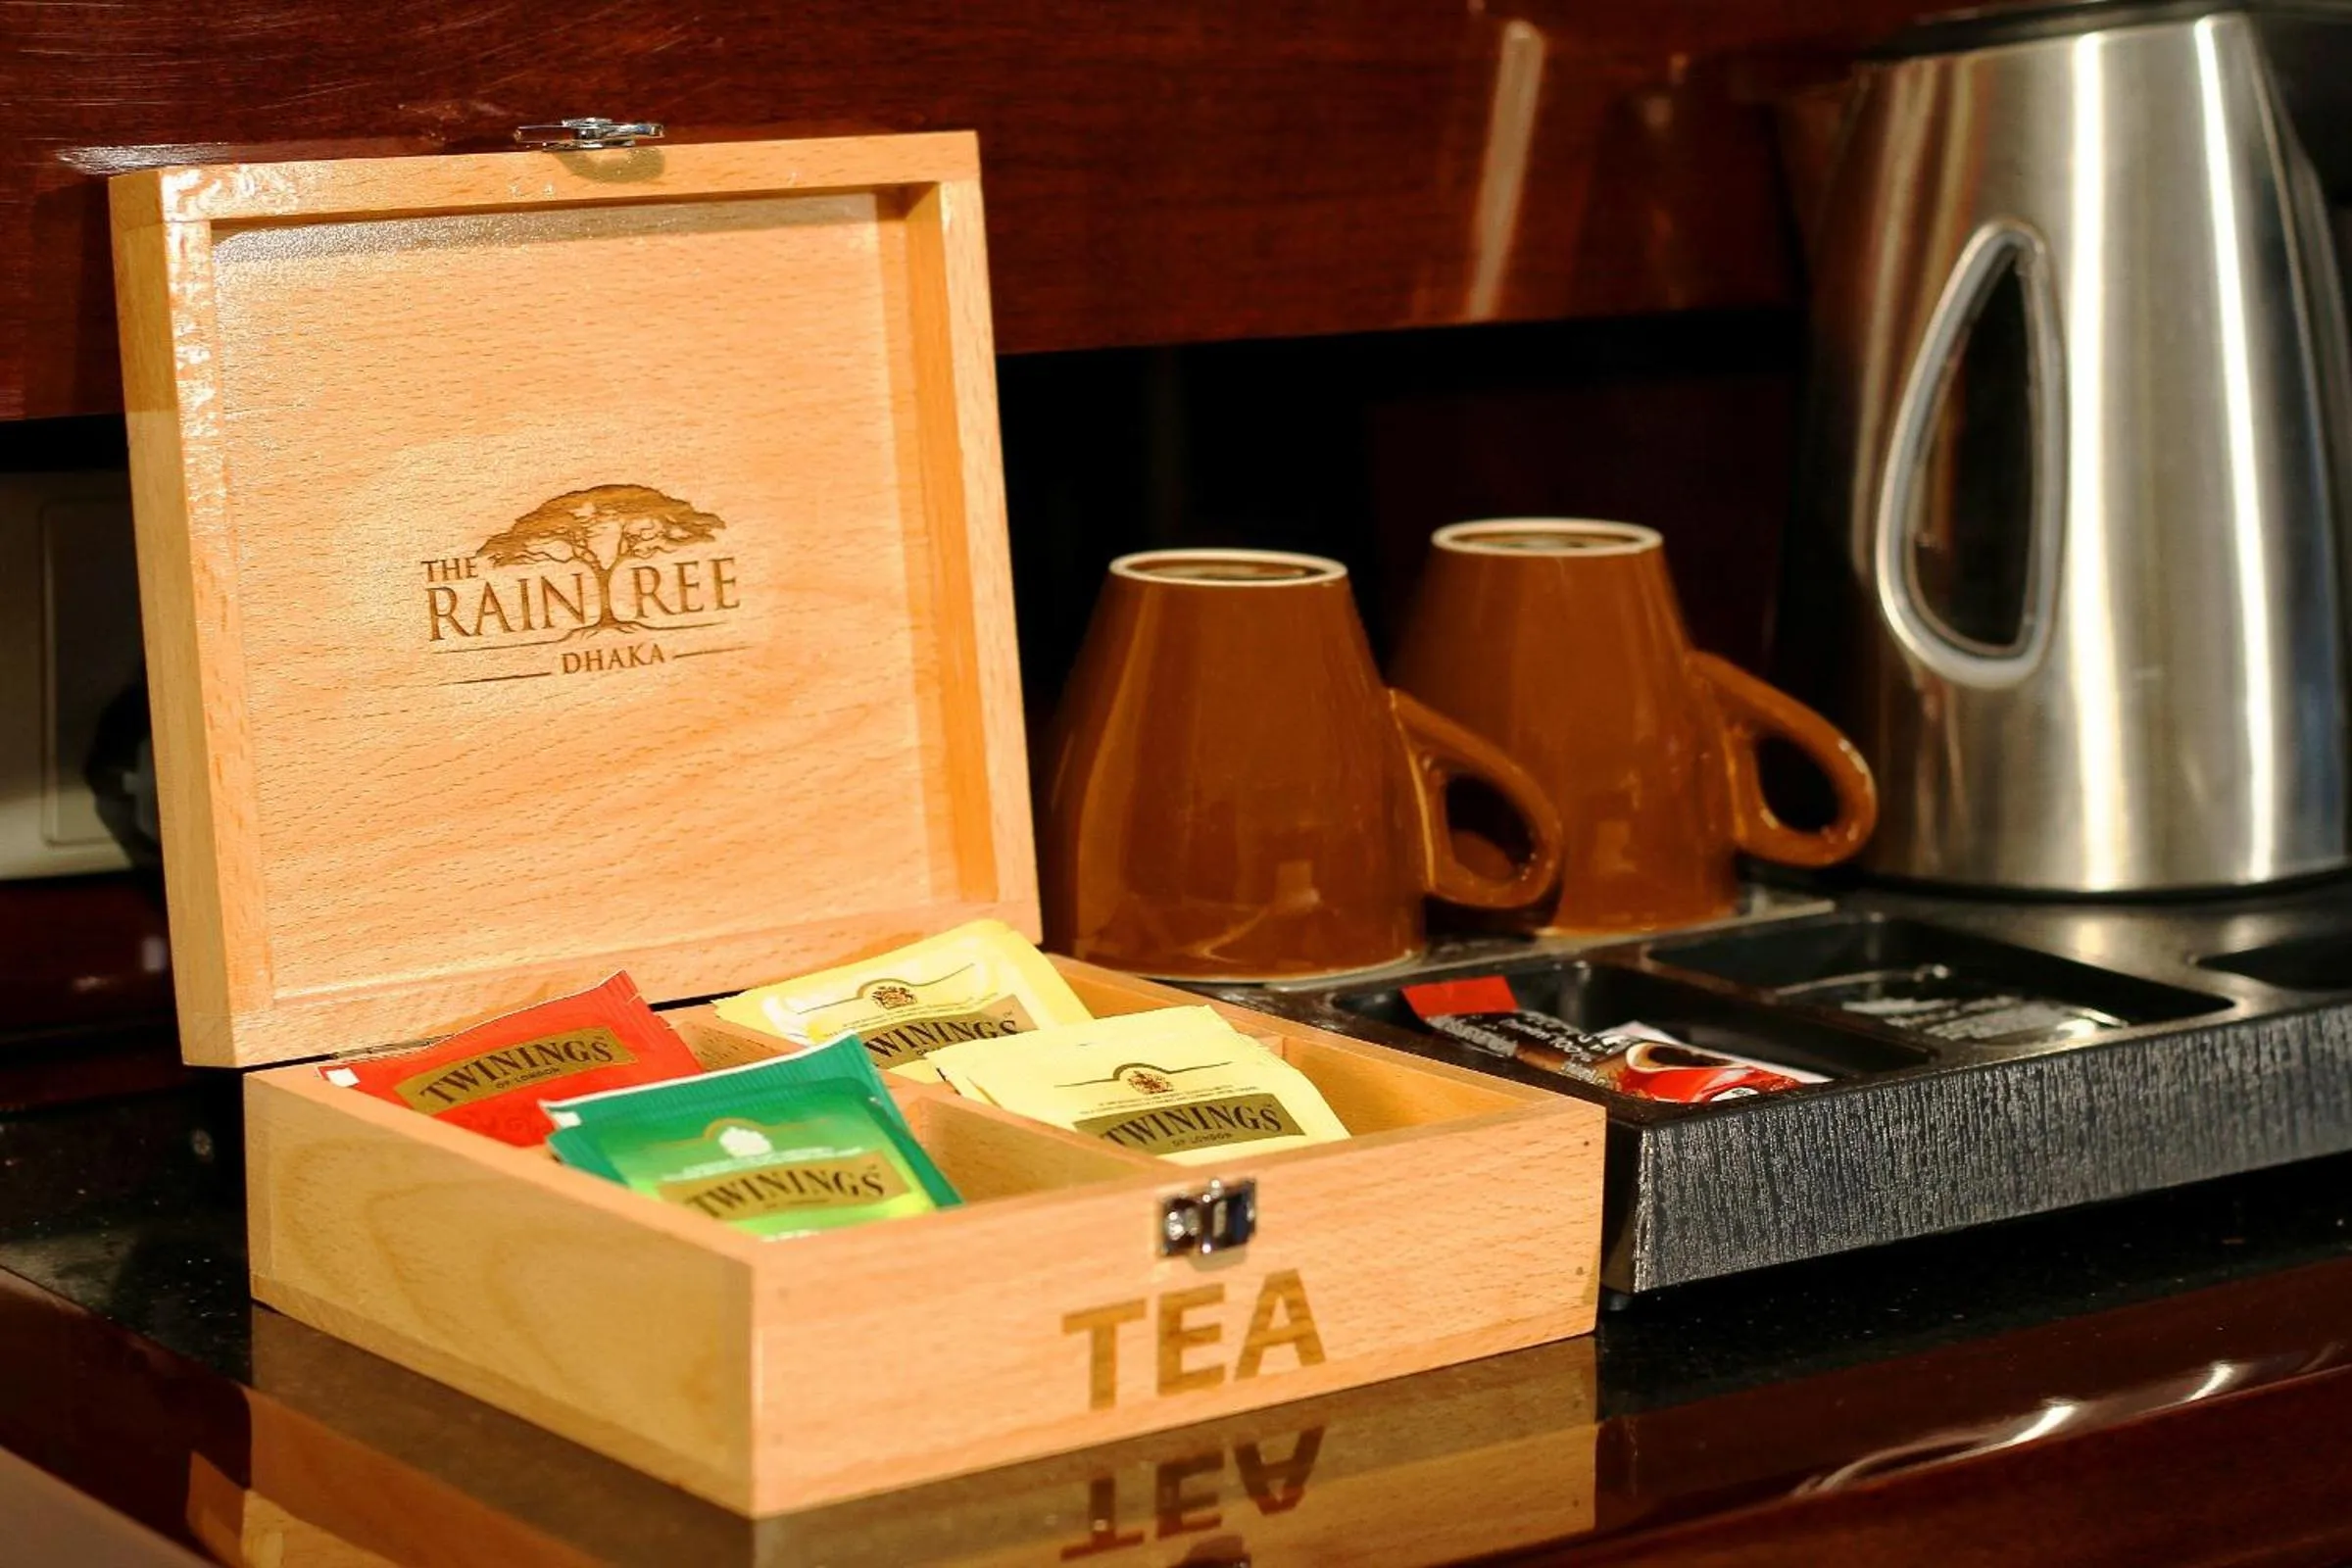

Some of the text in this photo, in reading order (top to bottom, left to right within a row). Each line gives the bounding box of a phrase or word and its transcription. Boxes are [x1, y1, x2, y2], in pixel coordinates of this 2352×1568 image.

[420, 556, 478, 582] THE
[562, 643, 665, 675] DHAKA
[863, 1018, 1017, 1064] WININGS
[419, 1039, 612, 1104] TWININGS
[1101, 1103, 1282, 1148] TWININGS
[686, 1168, 885, 1218] TWININGS
[1061, 1267, 1326, 1411] TEA
